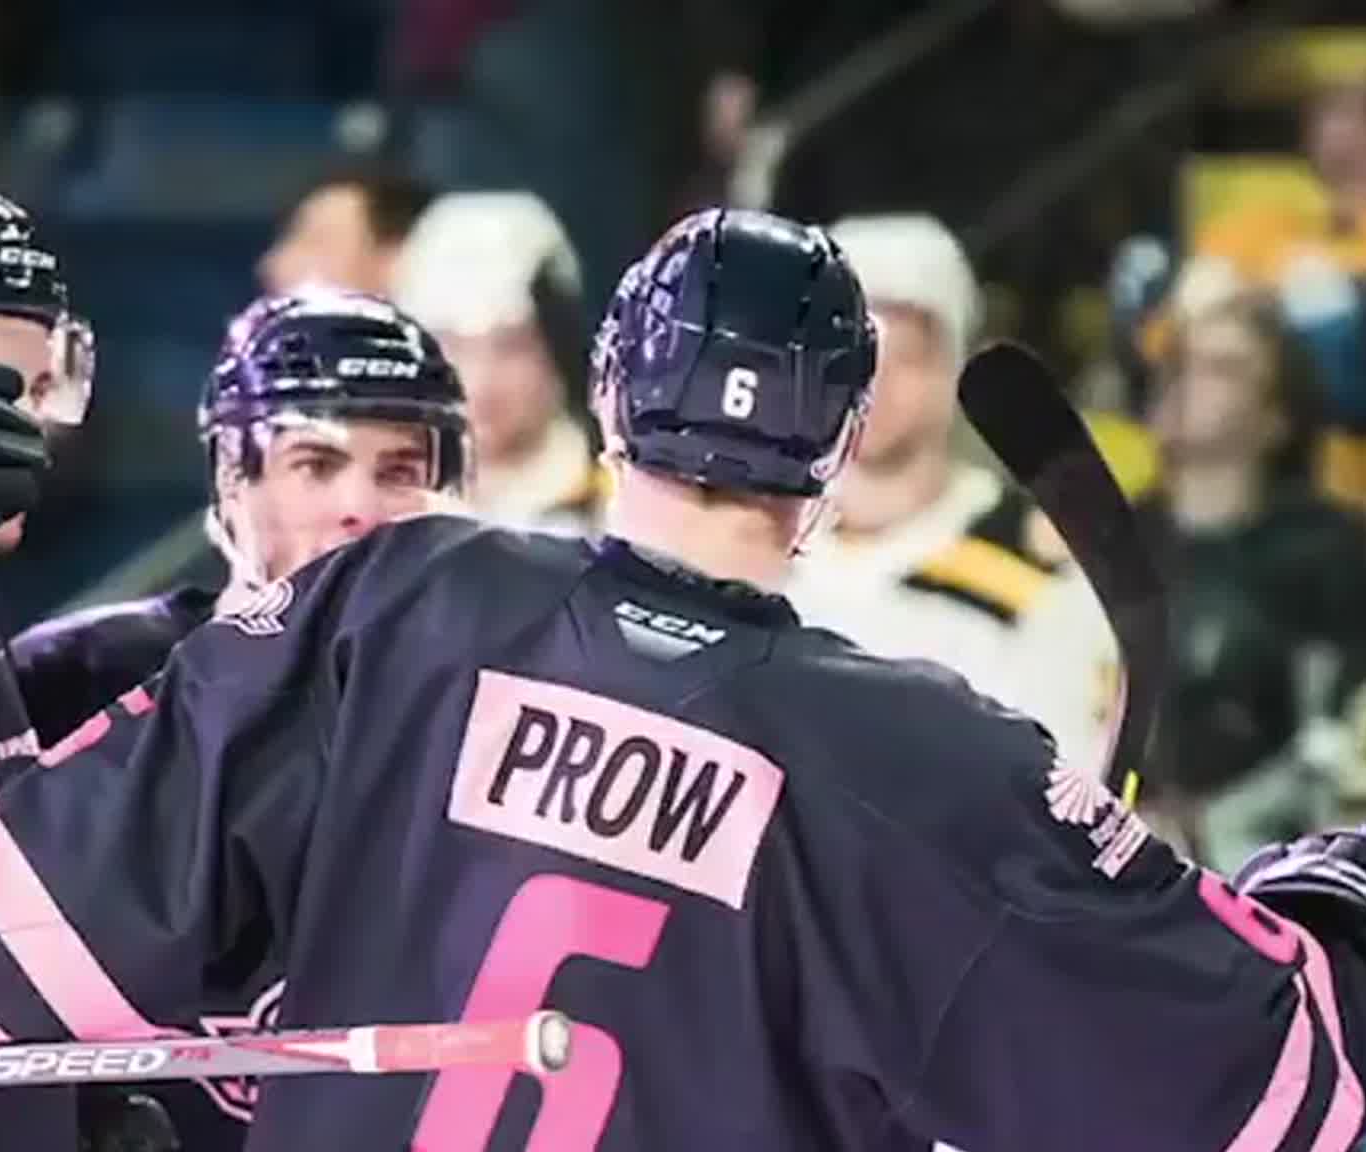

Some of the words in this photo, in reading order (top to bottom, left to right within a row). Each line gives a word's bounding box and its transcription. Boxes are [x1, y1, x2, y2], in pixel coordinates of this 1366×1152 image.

[336, 357, 419, 378] CCM
[721, 367, 759, 419] 6
[486, 704, 746, 864] PROW
